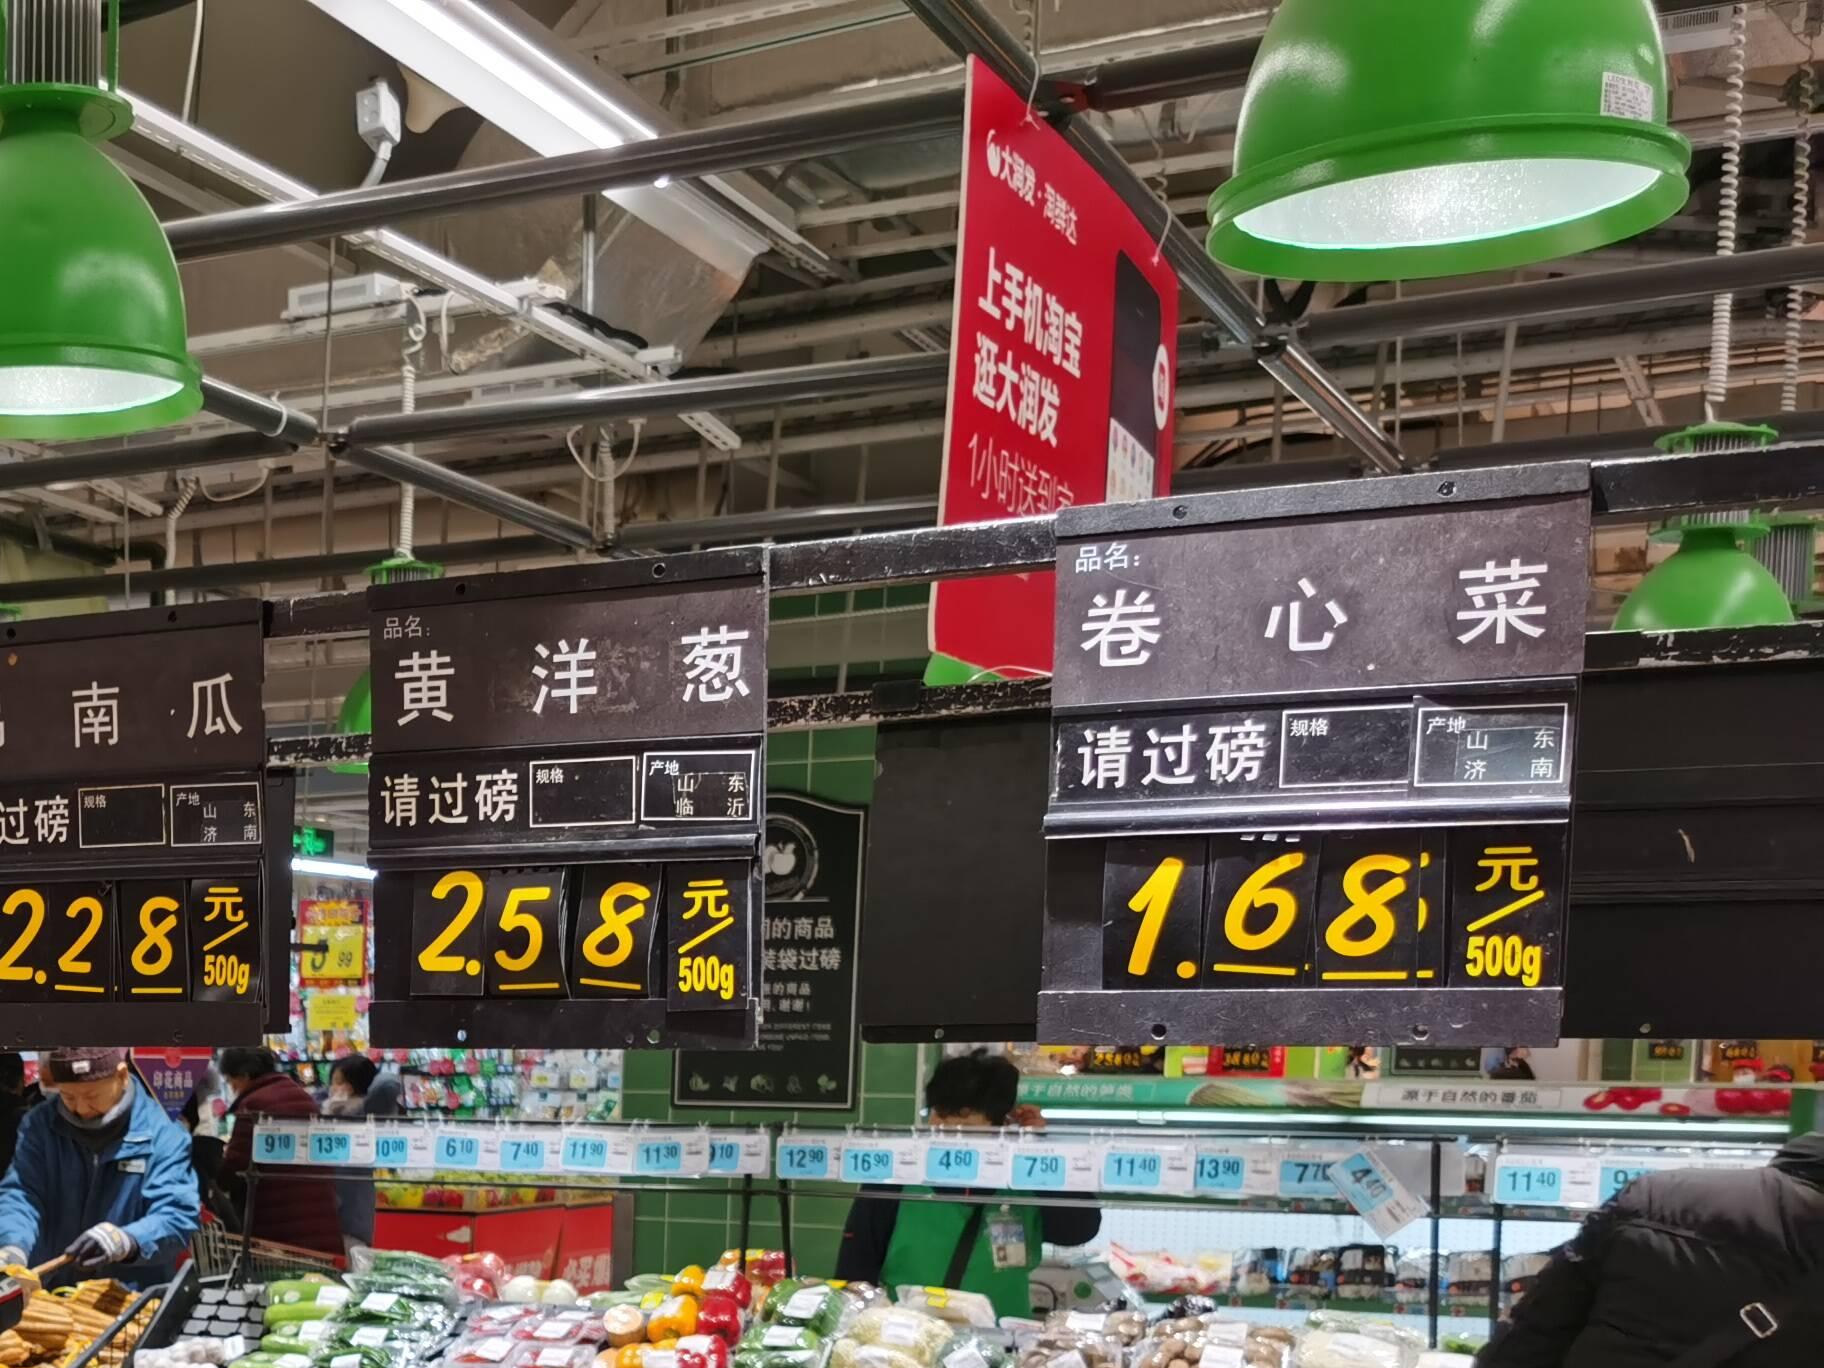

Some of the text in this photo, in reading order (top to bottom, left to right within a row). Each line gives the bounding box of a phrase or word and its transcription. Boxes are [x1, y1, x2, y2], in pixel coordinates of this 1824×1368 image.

[978, 246, 1083, 379] 上手机淘宝
[973, 331, 1060, 448] 逛大润发
[1080, 557, 1550, 668] 卷心菜
[394, 625, 751, 728] 黄洋葱
[1290, 719, 1329, 738] 规格
[1426, 715, 1467, 735] 产地
[1466, 727, 1556, 751] 山东
[536, 767, 564, 785] 规格
[648, 759, 679, 776] 产地
[1077, 720, 1268, 790] 请过磅
[84, 794, 107, 809] 规格
[175, 792, 201, 807] 产地
[380, 768, 519, 827] 请过磅
[677, 774, 745, 795] 山东
[203, 801, 257, 820] 山东
[417, 870, 651, 976] 2.58
[1127, 853, 1414, 980] 1.68
[203, 954, 250, 994] 500g
[678, 956, 735, 1001] 500g
[1465, 935, 1543, 988] 500g
